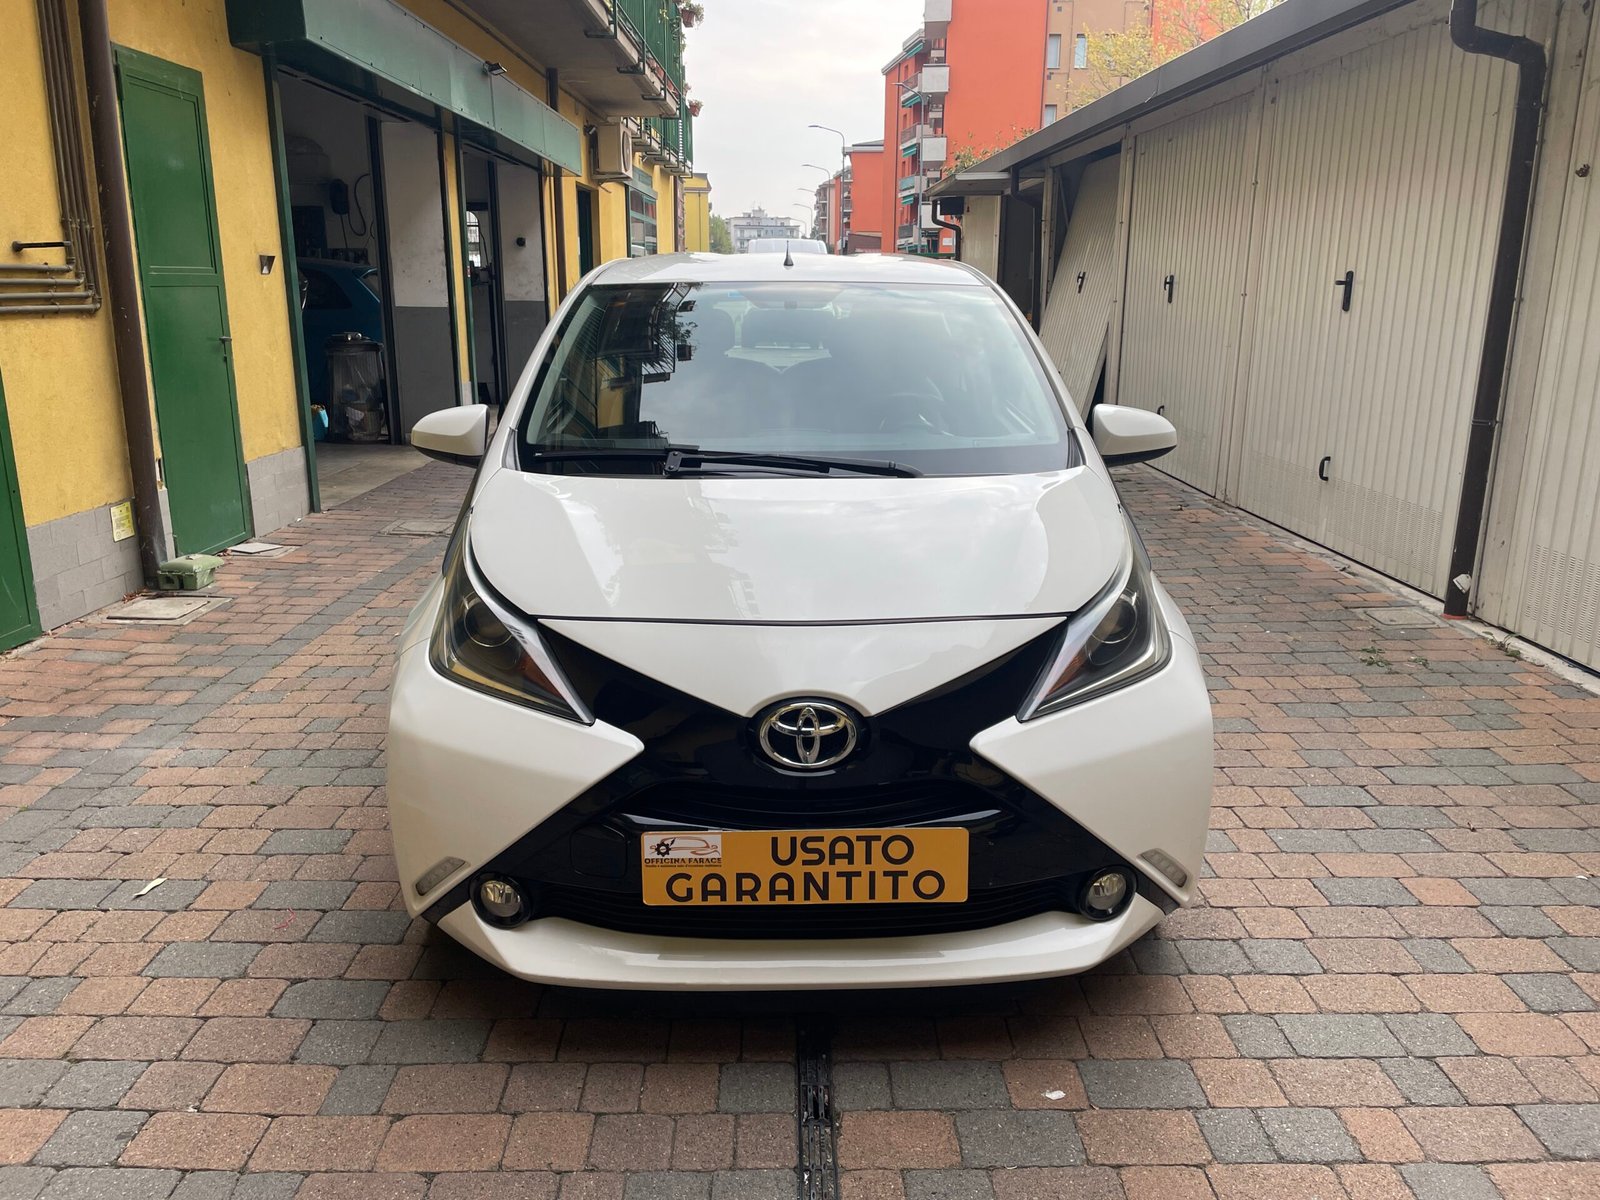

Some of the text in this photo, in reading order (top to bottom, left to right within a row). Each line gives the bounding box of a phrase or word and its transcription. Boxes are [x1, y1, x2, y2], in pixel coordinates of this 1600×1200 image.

[644, 857, 686, 865] OFFICINA
[771, 834, 915, 866] USATO
[665, 869, 946, 903] GARANTITO
